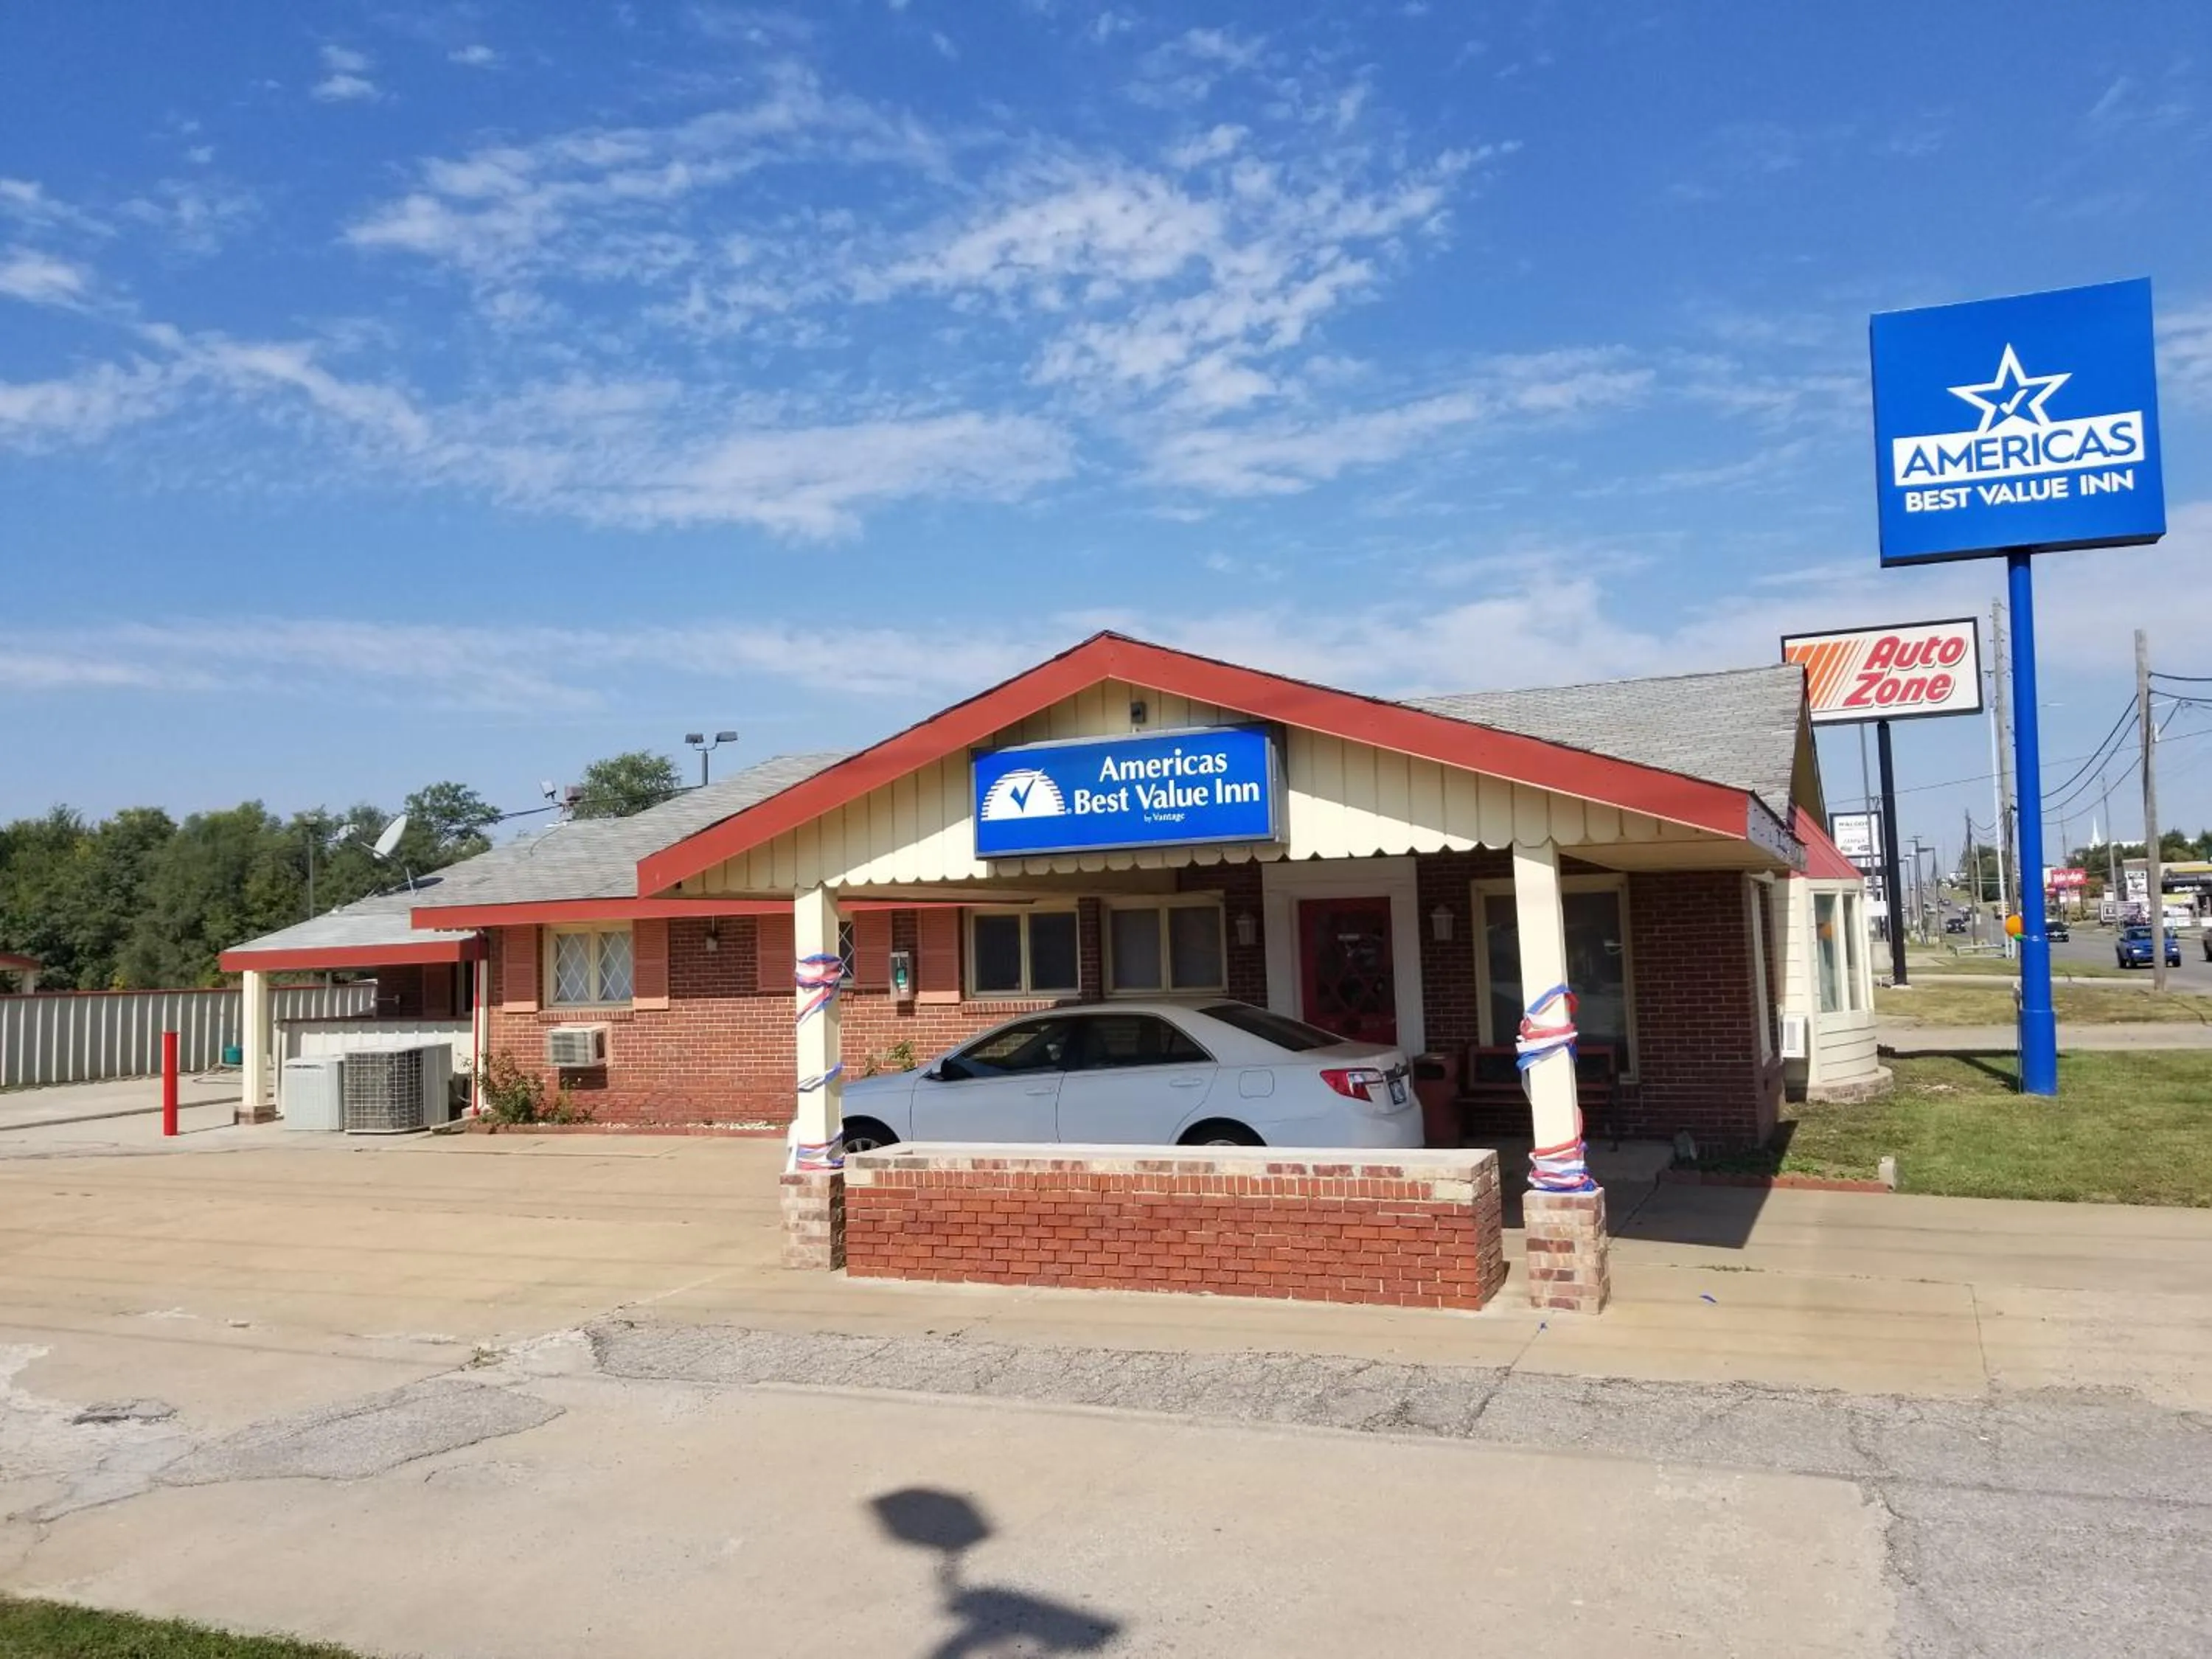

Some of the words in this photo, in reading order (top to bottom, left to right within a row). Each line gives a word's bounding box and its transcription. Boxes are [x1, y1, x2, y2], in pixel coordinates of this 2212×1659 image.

[1902, 421, 2137, 479] AMERICAS
[1905, 487, 1971, 513] BEST
[1978, 478, 2068, 505] VALUE
[2079, 470, 2134, 496] INN
[1863, 636, 1965, 670] Auto
[1842, 672, 1953, 707] Zone
[1099, 748, 1228, 782] Americas
[1074, 787, 1129, 814] Best
[1135, 781, 1208, 810] Value
[1216, 779, 1260, 804] Inn
[1152, 813, 1186, 823] Vantage
